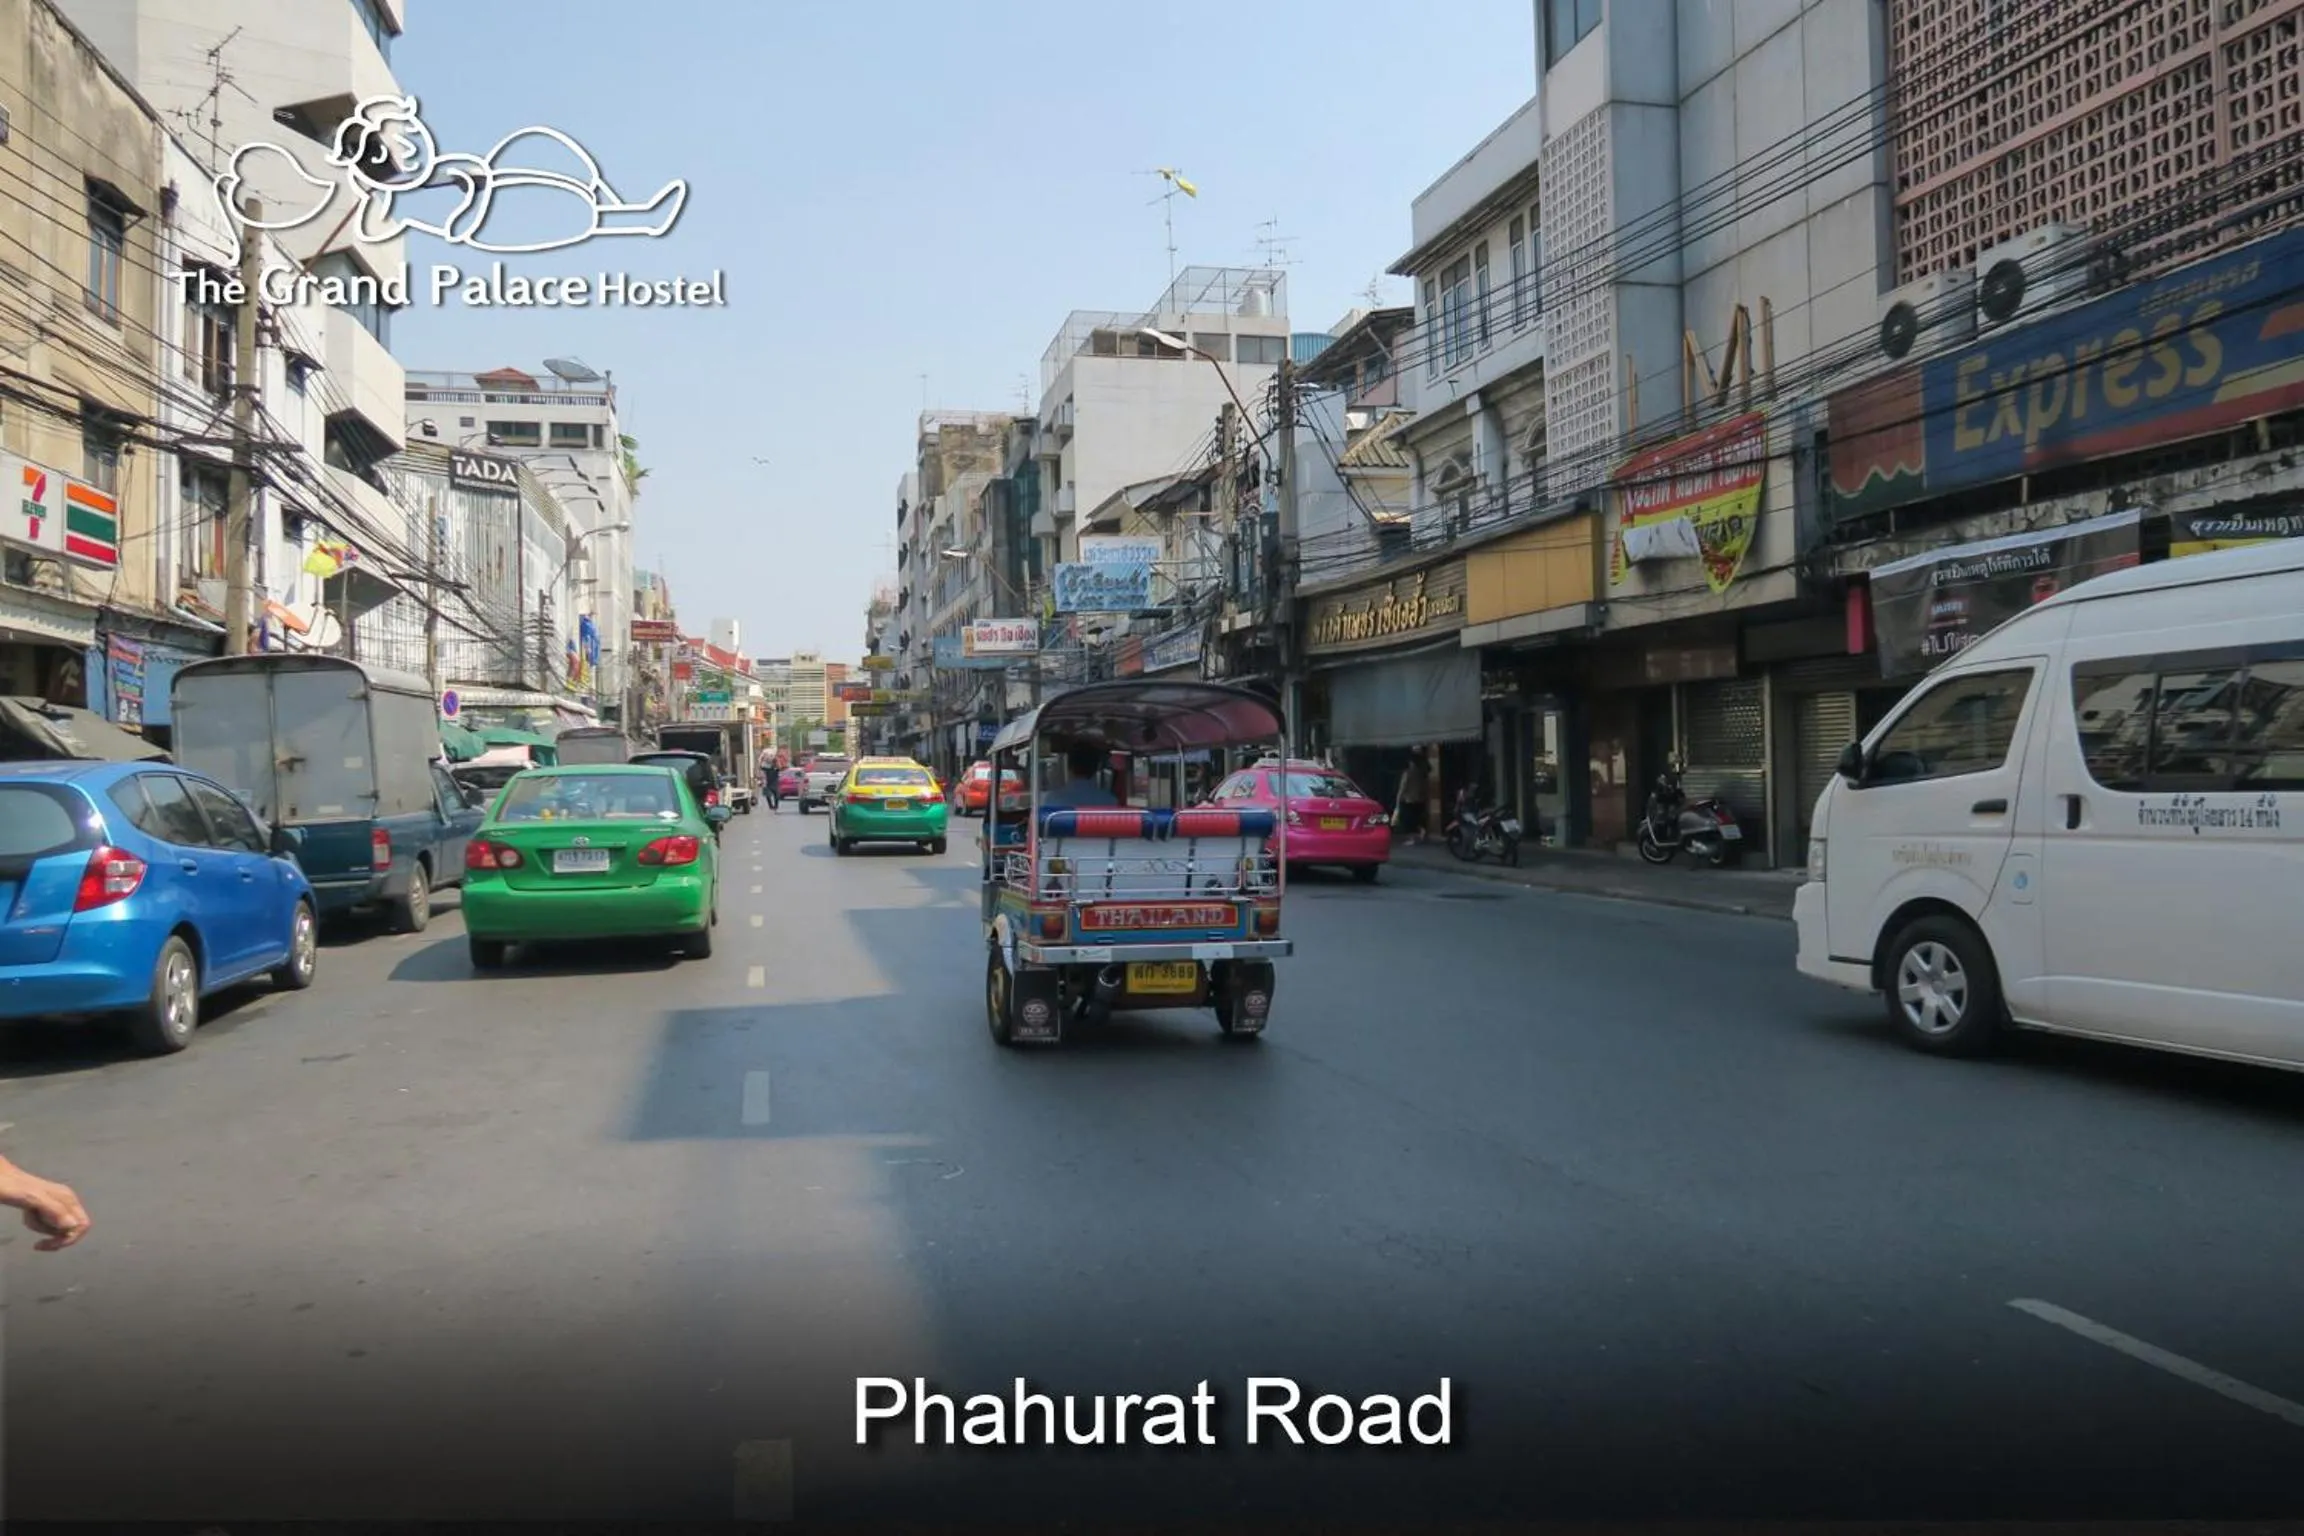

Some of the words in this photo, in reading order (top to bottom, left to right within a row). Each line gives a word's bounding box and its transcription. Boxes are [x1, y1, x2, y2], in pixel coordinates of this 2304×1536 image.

[1953, 300, 2225, 454] Express
[452, 455, 518, 484] TADA
[1093, 907, 1226, 927] THAILAND
